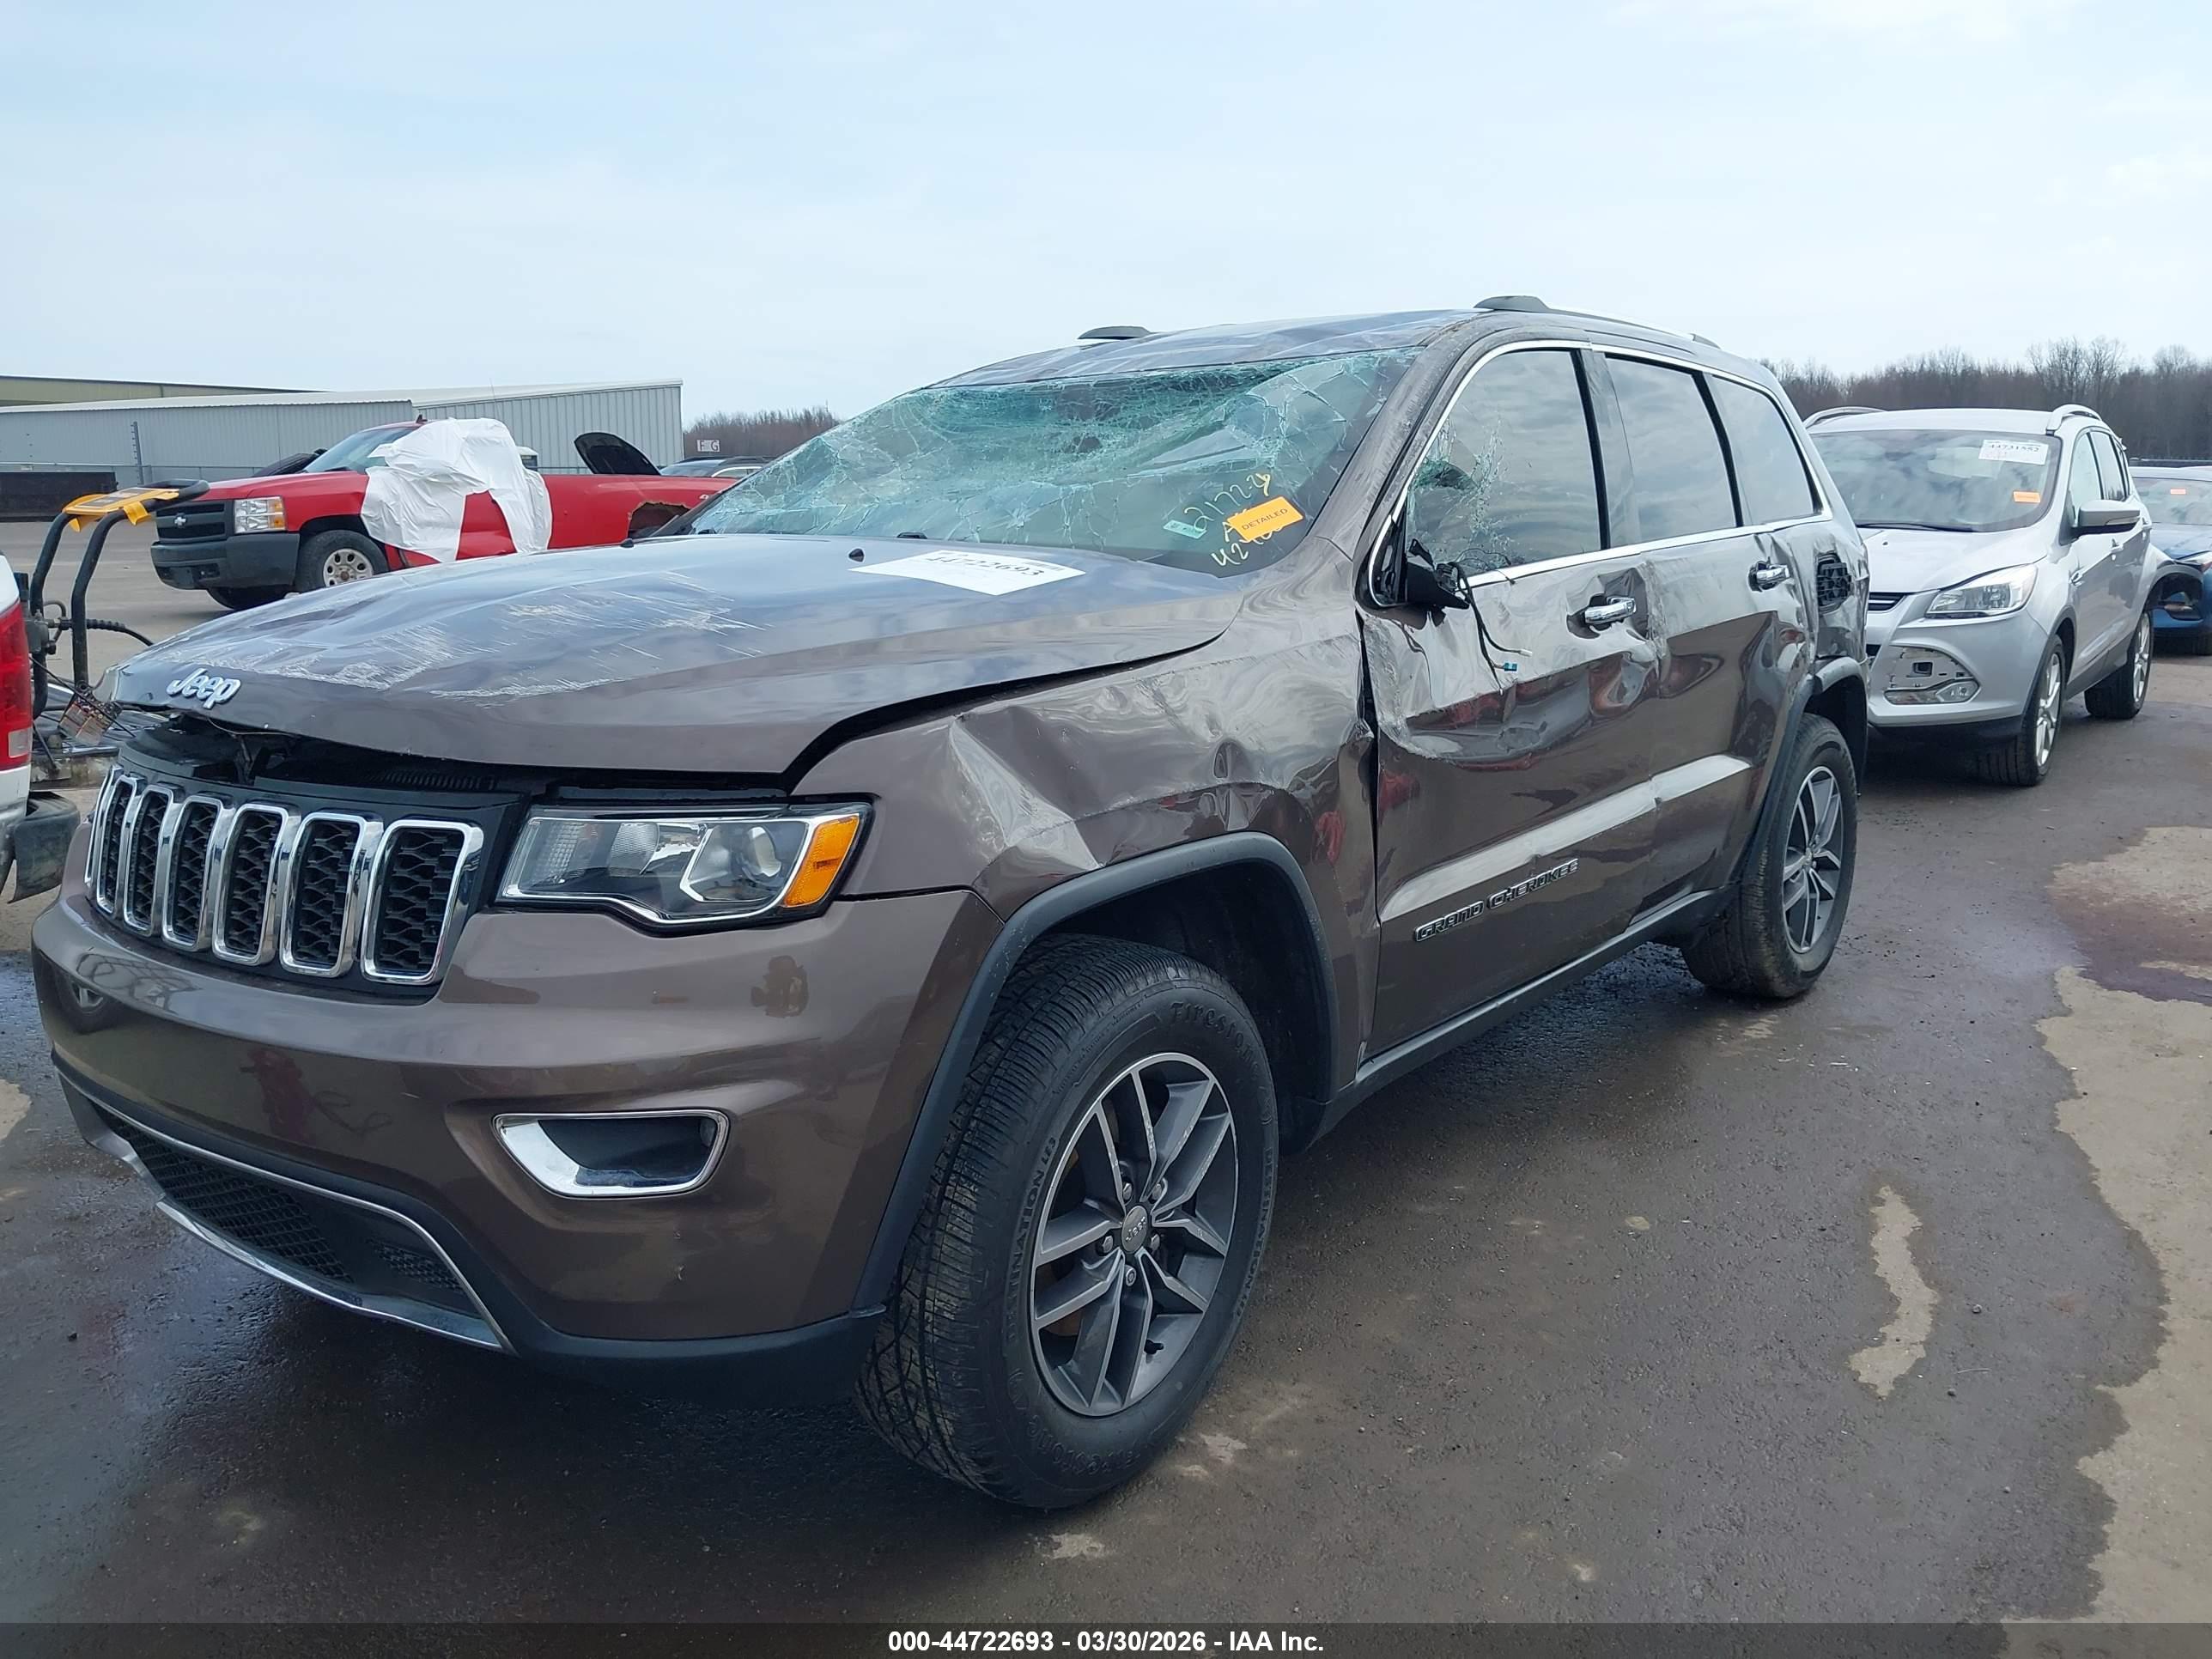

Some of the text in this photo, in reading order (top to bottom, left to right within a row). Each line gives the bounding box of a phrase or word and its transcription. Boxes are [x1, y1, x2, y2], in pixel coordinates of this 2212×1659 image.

[710, 439, 720, 452] G
[1241, 507, 1288, 532] DETAILED
[166, 667, 241, 710] Jeep
[1415, 858, 1579, 942] GRAND CHEROKEE
